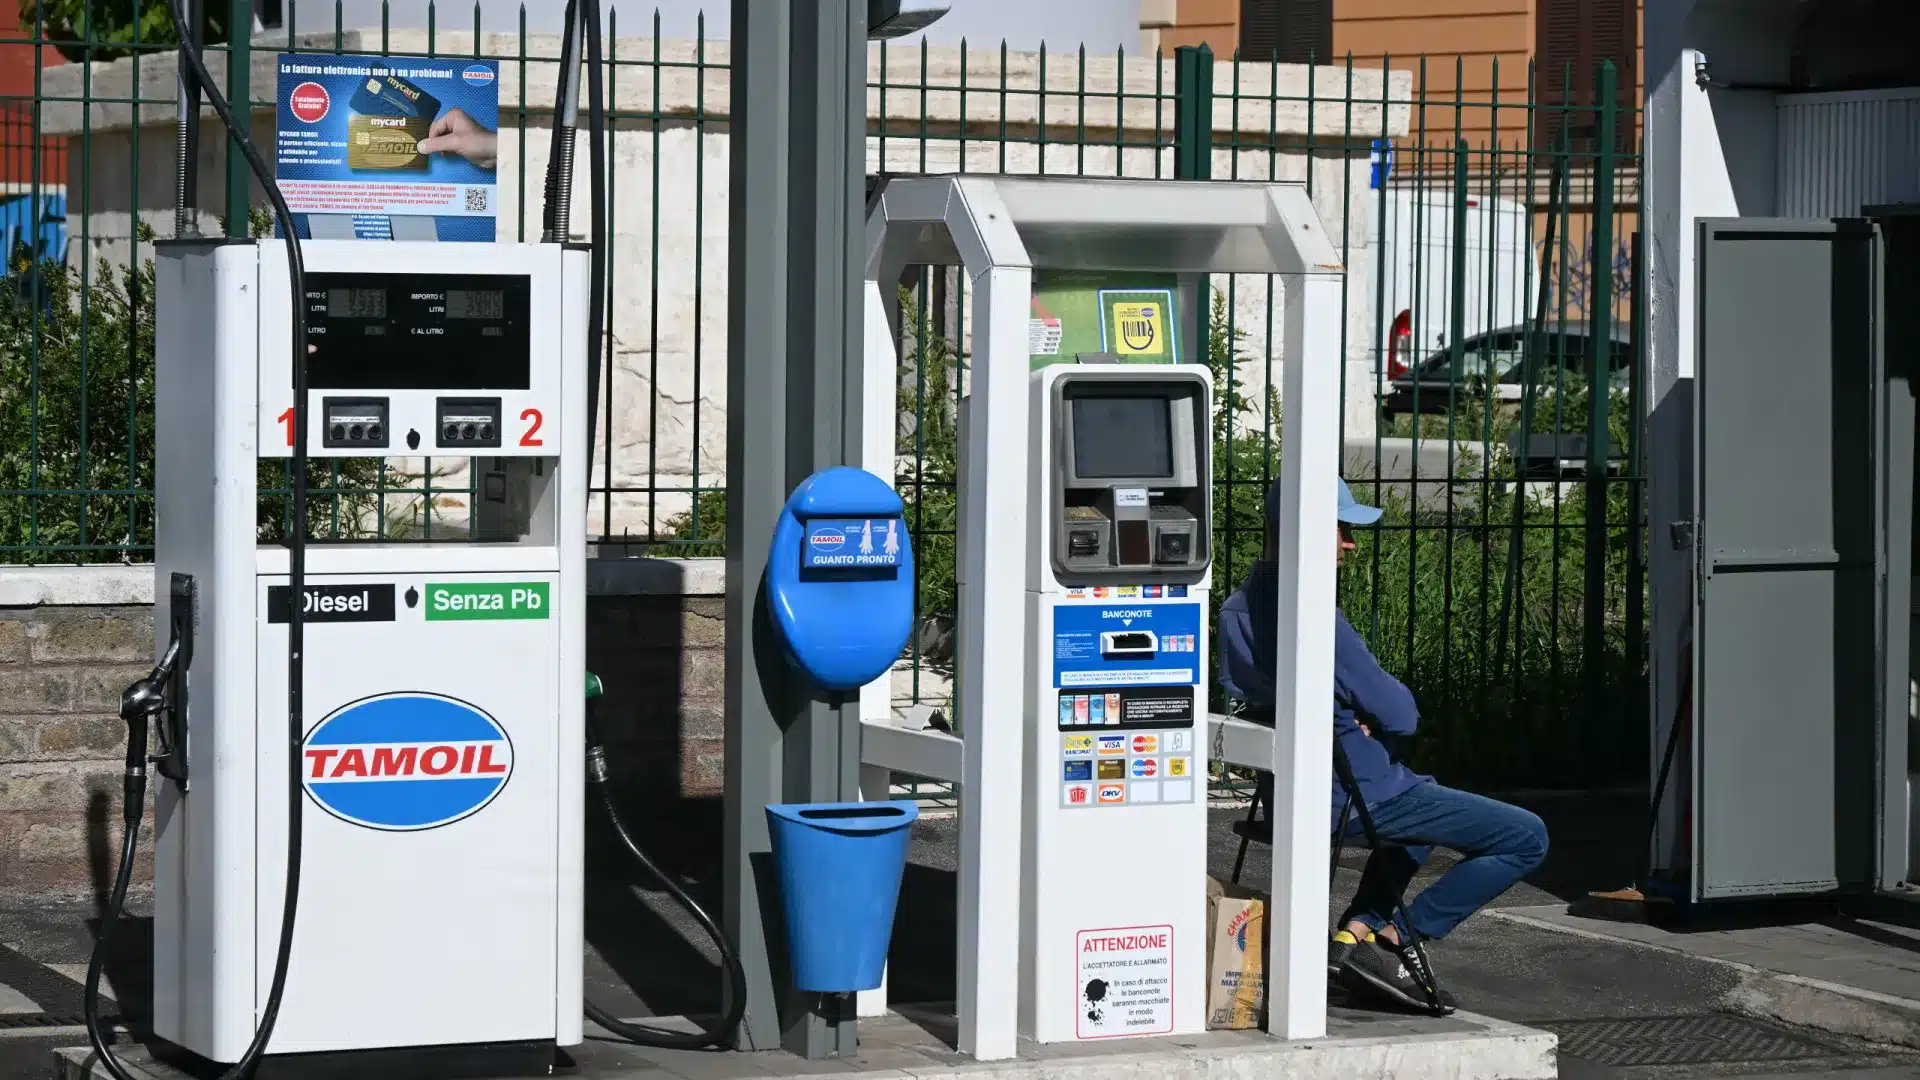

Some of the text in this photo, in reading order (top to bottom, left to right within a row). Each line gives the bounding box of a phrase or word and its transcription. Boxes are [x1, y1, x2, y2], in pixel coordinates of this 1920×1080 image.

[281, 63, 291, 74] La
[292, 64, 322, 74] fattura
[324, 65, 372, 76] elettronica
[372, 68, 389, 76] non
[397, 69, 408, 77] un
[410, 68, 454, 79] problema!
[387, 76, 420, 101] mycard
[370, 117, 406, 128] mycard
[277, 407, 294, 446] 1
[519, 408, 544, 446] 2
[813, 555, 896, 565] GUANTO PRONTO
[434, 588, 542, 611] Senza Pb
[1102, 610, 1152, 618] BANCONOTE
[305, 745, 506, 778] TAMOIL
[1084, 934, 1167, 952] ATTENZIONE
[1082, 960, 1127, 970] L'ACCETTATORE
[1134, 958, 1168, 966] ALLARMATO
[1126, 1018, 1156, 1026] indelebile
